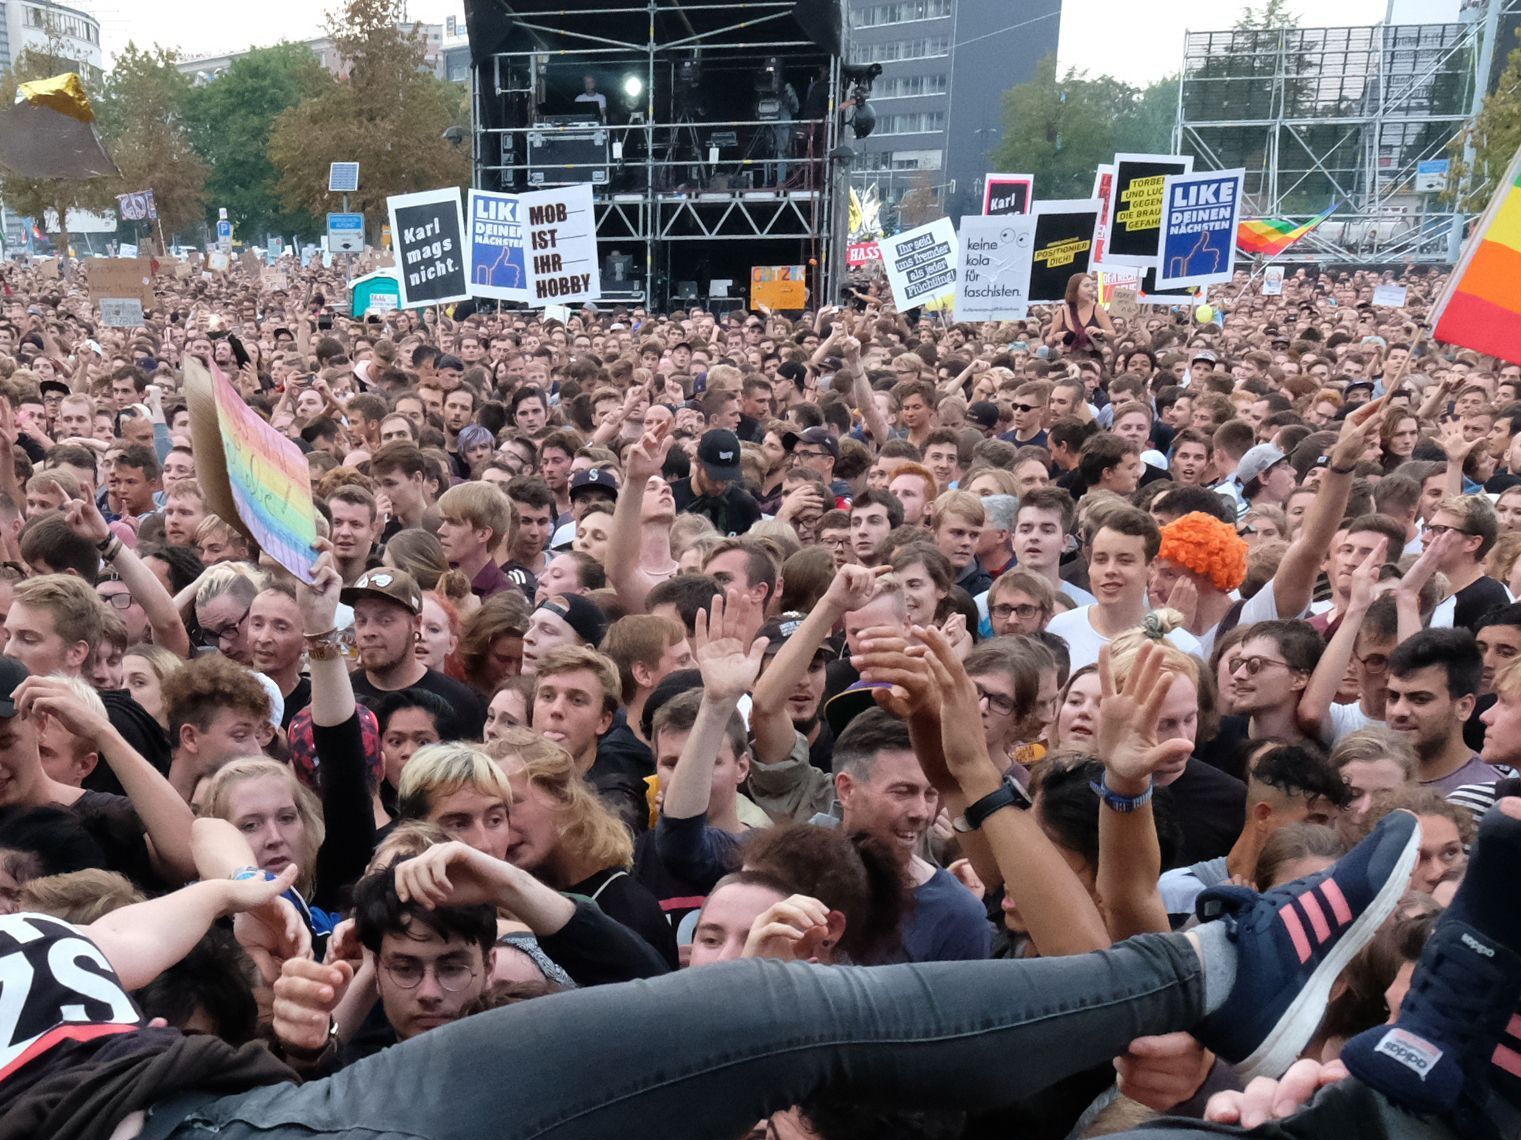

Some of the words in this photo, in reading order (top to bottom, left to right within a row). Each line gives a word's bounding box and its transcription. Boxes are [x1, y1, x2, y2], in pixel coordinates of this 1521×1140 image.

[990, 192, 1016, 211] Karl
[1126, 190, 1144, 199] UND
[1133, 198, 1162, 208] GEGEN
[1174, 182, 1234, 207] LIKE
[529, 203, 567, 226] MOB
[1120, 211, 1134, 220] DIE
[1171, 206, 1231, 224] DEINEN
[404, 217, 440, 244] Karl
[1170, 220, 1230, 235] NÄCHSTEN
[531, 229, 558, 250] IST
[898, 242, 914, 255] Ihr
[967, 238, 998, 250] keine
[406, 238, 452, 264] mags
[850, 246, 880, 261] HASS
[896, 257, 914, 271] uns
[914, 244, 949, 264] fremder
[1036, 242, 1088, 259] POSITIONIER
[533, 254, 562, 274] IHR
[966, 254, 990, 266] kola
[1050, 255, 1072, 266] DICH!
[409, 258, 459, 286] nicht.
[910, 269, 924, 281] als
[925, 260, 947, 276] jeder
[965, 269, 980, 282] für
[536, 273, 590, 298] HOBBY
[964, 284, 1021, 298] faschisten.
[1461, 933, 1495, 958] adidas
[1383, 1041, 1427, 1069] adidas
